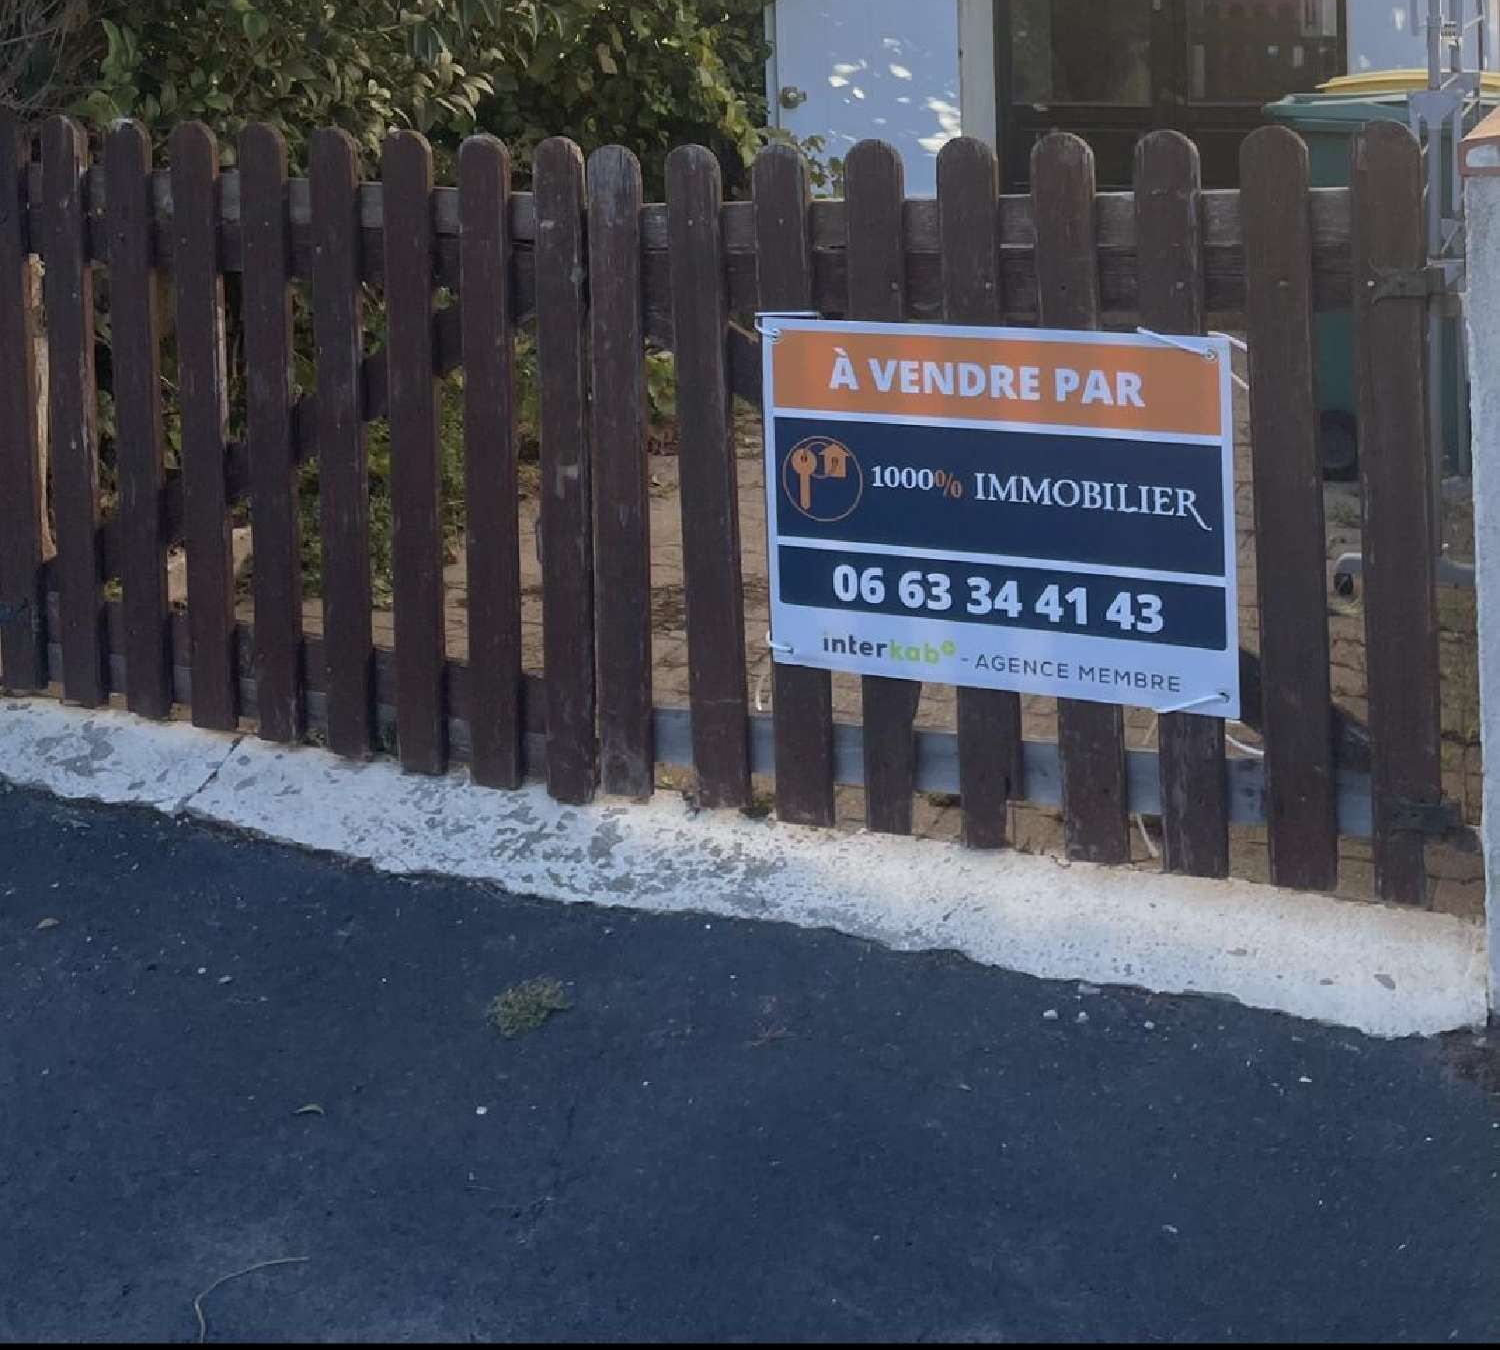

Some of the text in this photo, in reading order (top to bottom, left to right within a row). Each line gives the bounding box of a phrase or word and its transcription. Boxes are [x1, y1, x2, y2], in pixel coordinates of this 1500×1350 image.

[829, 348, 1146, 408] À VENDRE PAR
[871, 465, 1212, 531] 1000% IMMOBILIER
[832, 564, 1164, 633] 06 63 34 41 43
[974, 654, 1069, 680] AGENCE
[1078, 666, 1182, 693] MEMBRE
